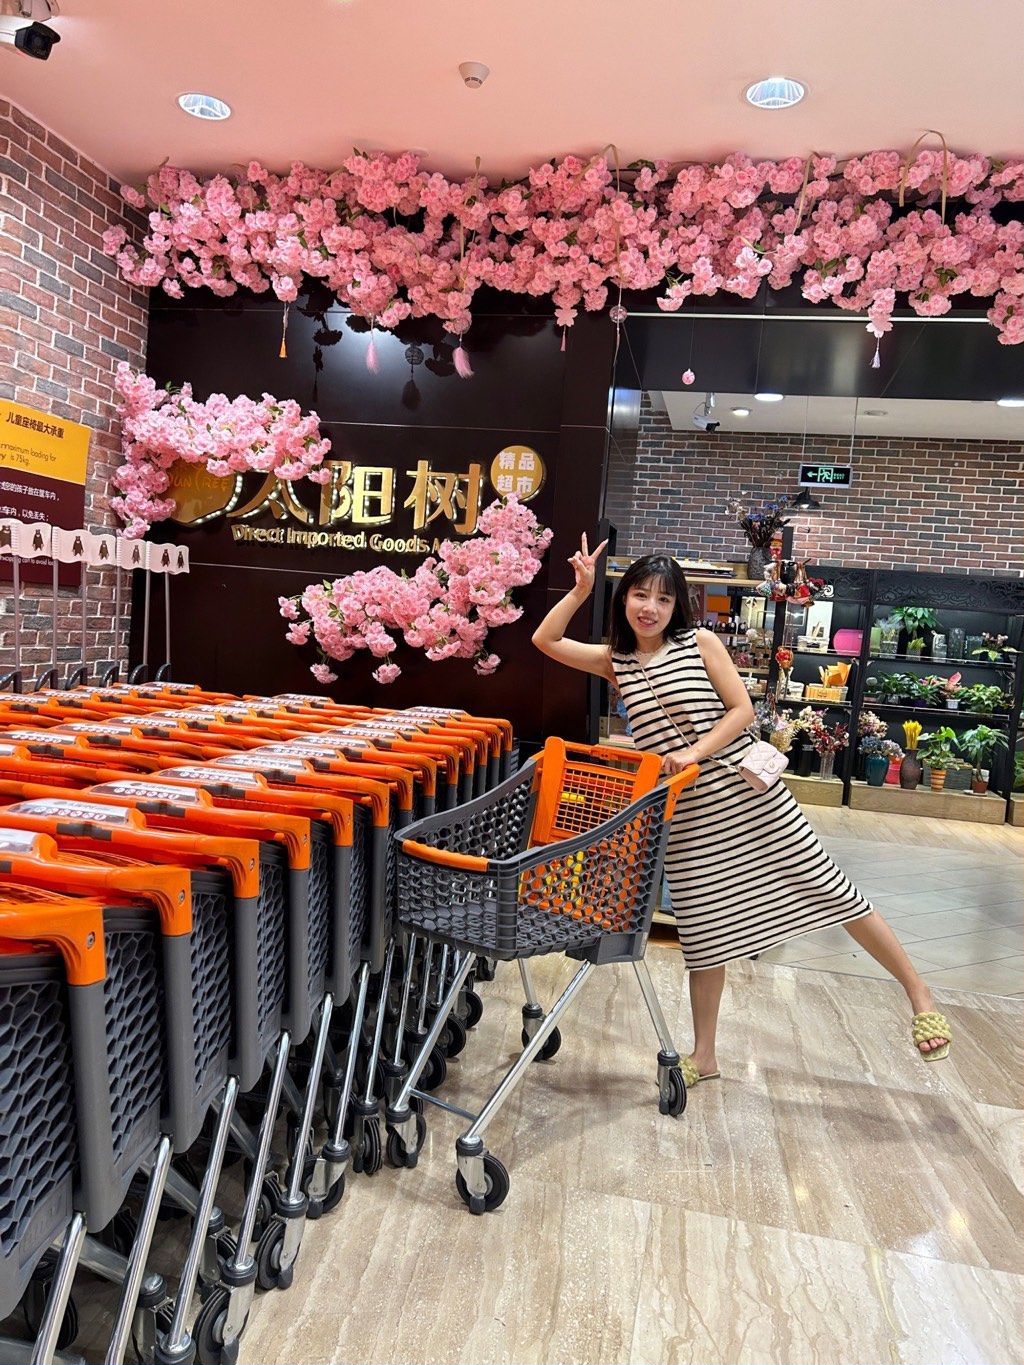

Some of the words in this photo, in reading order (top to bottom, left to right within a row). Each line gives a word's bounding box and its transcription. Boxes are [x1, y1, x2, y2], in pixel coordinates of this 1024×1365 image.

[498, 451, 536, 471] 精品
[497, 474, 535, 495] 超市
[231, 525, 285, 542] Direct
[286, 528, 366, 549] Imported
[370, 534, 430, 554] Goods
